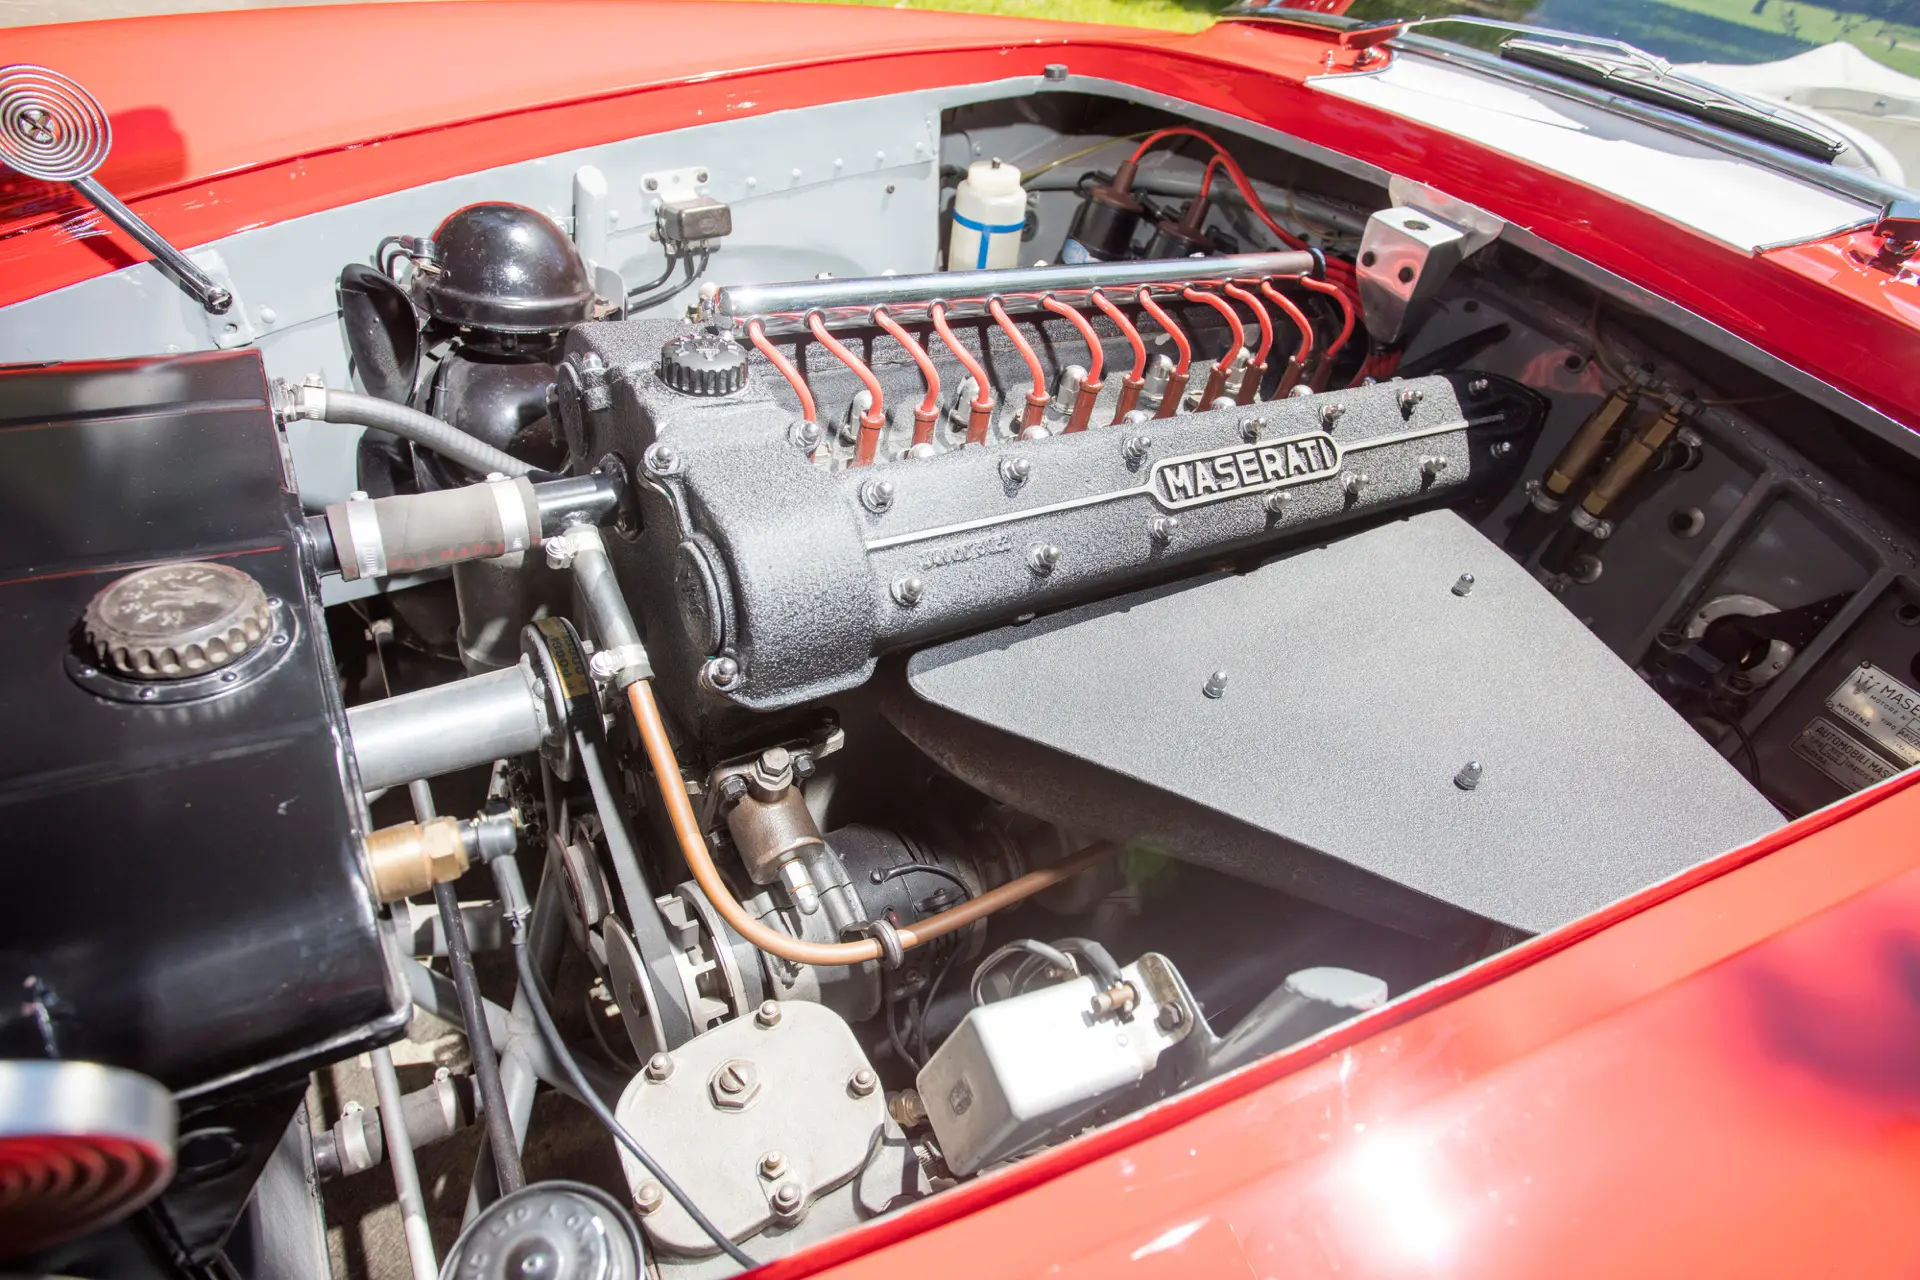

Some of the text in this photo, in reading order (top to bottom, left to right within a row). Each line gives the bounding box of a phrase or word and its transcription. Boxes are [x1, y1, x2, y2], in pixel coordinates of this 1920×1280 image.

[1164, 438, 1332, 500] MASERATI
[1837, 702, 1871, 728] MODENA
[1869, 694, 1898, 716] MOTORE
[1816, 726, 1869, 765] AUTOMOBILI
